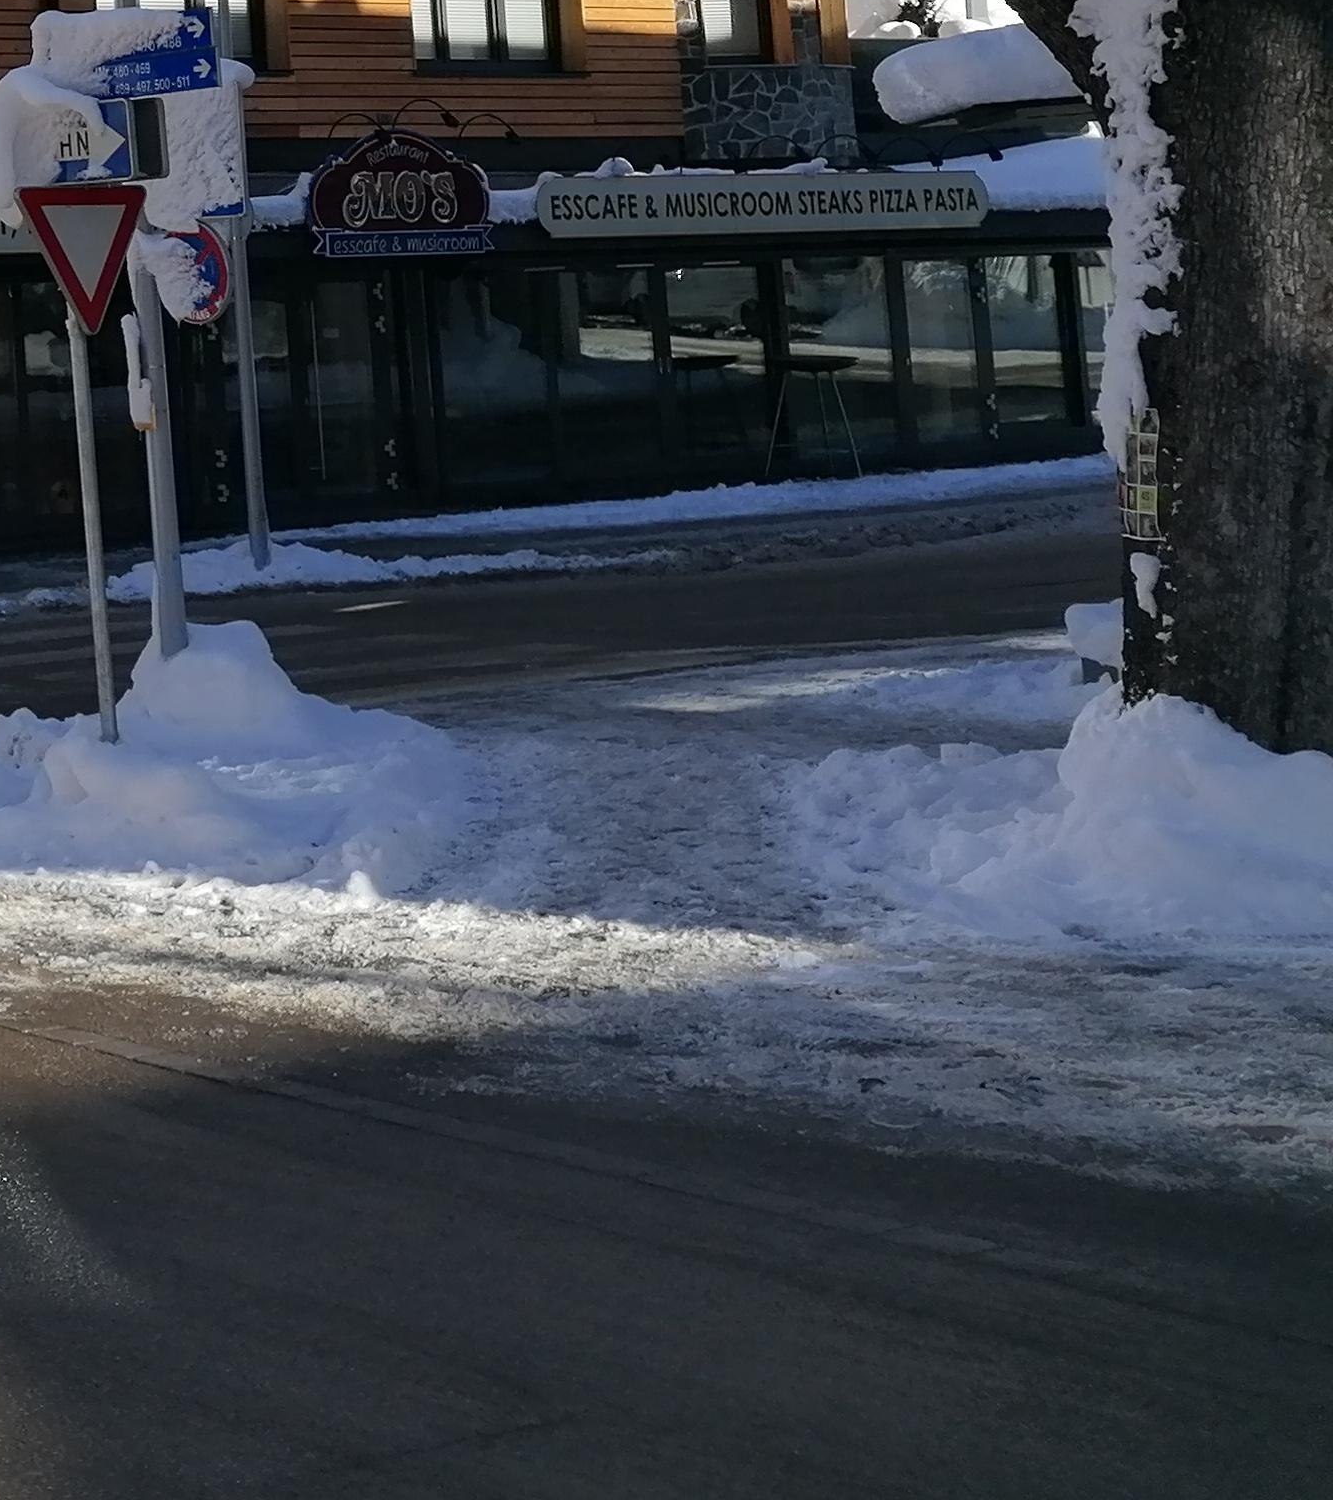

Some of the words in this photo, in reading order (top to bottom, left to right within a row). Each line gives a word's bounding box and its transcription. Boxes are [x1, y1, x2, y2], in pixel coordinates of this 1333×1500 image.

[366, 143, 430, 165] Restaurant
[550, 193, 638, 221] ESSCAFE
[645, 193, 659, 220] &
[665, 190, 793, 218] MUSICROOM
[797, 188, 864, 216] STEAKS
[868, 188, 919, 214] PIZZA
[923, 186, 980, 213] PASTA
[333, 234, 387, 254] esscafe
[407, 233, 480, 252] musicroom
